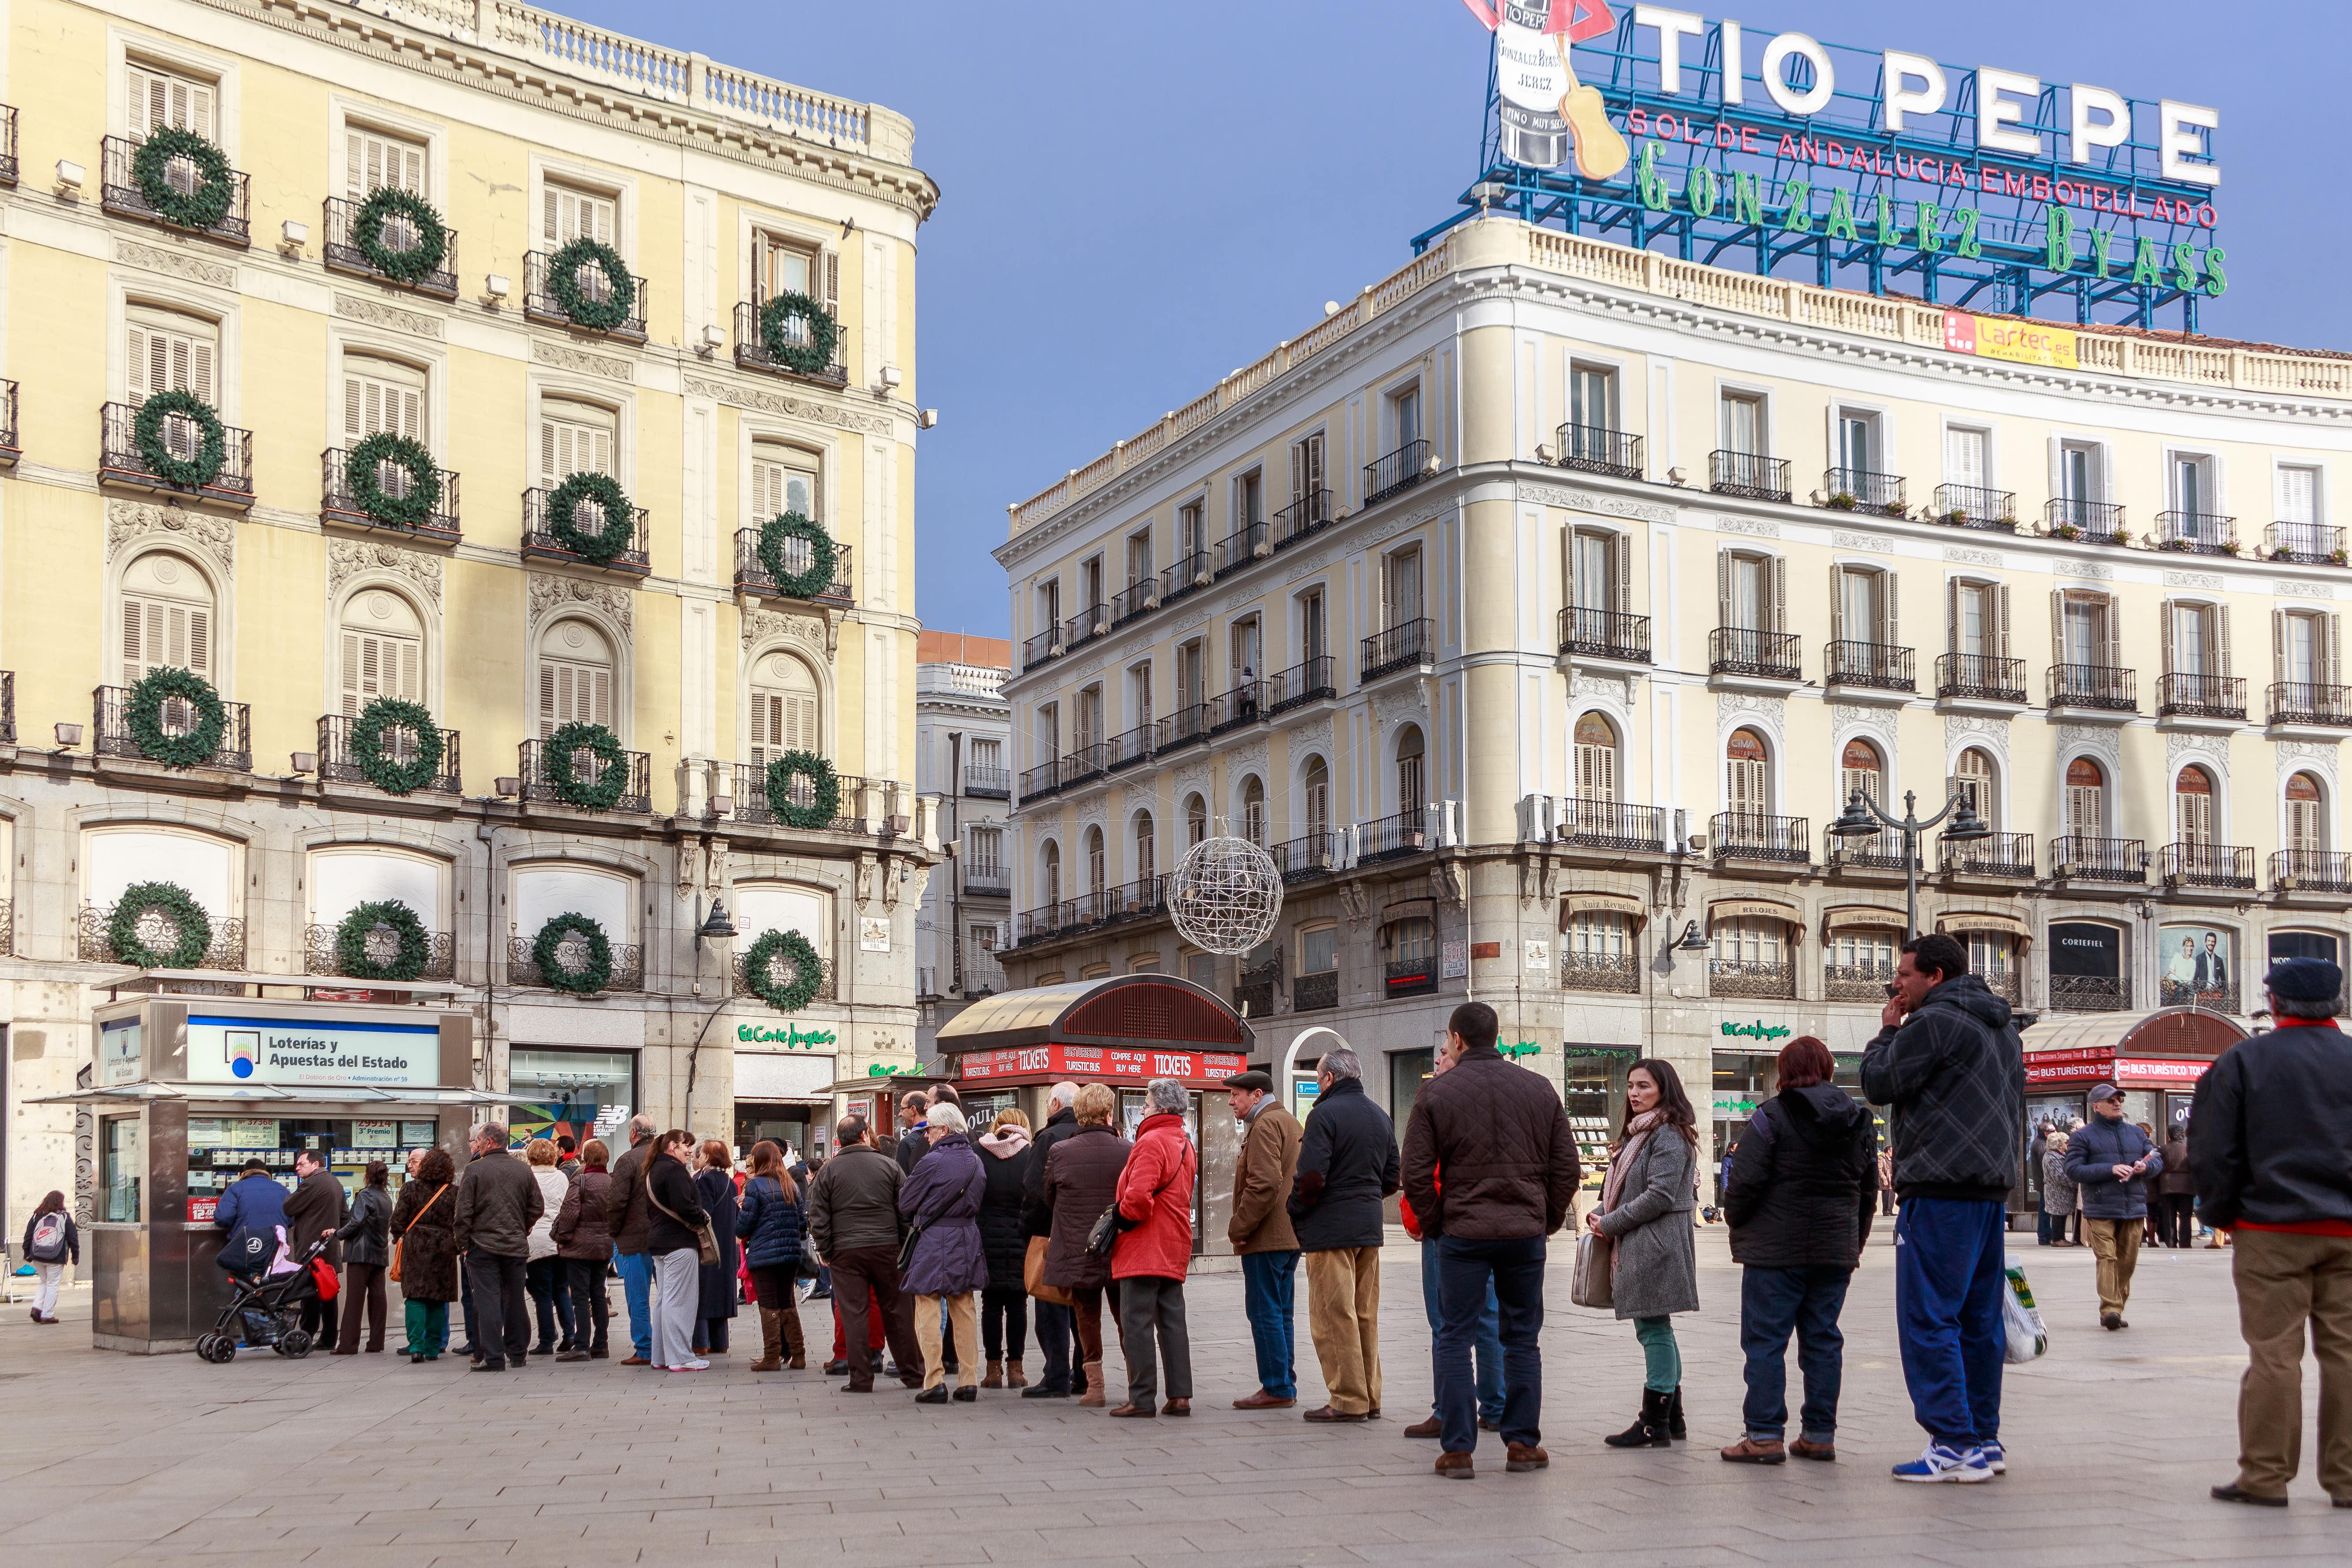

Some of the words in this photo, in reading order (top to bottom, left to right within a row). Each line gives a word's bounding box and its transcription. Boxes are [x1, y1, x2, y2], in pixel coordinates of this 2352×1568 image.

[1498, 37, 1537, 67] GONZALEZ
[1538, 49, 1561, 67] BYASS
[1518, 74, 1552, 91] JEREZ
[1635, 4, 1834, 115] TIO
[1882, 48, 2221, 186] PEPE
[1506, 107, 1528, 125] VINO
[1532, 116, 1549, 129] MUY
[1629, 109, 1703, 145] SOL
[1715, 123, 1760, 153] DE
[1776, 134, 1967, 188] ANDALUCIA
[1981, 168, 2218, 227] EMBOTELLADO
[1637, 140, 1981, 258] GONZALEZ
[2046, 205, 2227, 296] BYASS
[1981, 323, 2070, 356] Lartec.es
[1582, 900, 1600, 909] Ruiz
[1603, 899, 1635, 911] Revuelto
[2062, 938, 2103, 947] CORTEFIEL
[738, 1024, 753, 1043] El
[754, 1025, 787, 1044] Corte
[788, 1022, 836, 1049] Inglés
[1723, 1022, 1734, 1036] El
[1734, 1023, 1757, 1036] Corte
[1756, 1020, 1790, 1041] Inglés
[269, 1037, 326, 1050] Loterías
[330, 1041, 337, 1053] y
[1064, 1047, 1075, 1057] BUS
[1075, 1048, 1103, 1059] TURISTICO
[270, 1053, 334, 1068] Apuestas
[337, 1055, 358, 1067] del
[362, 1056, 408, 1069] Estado
[996, 1052, 1007, 1061] COMPRE
[1018, 1048, 1049, 1070] TICKETS
[1111, 1052, 1131, 1061] COMPRE
[1133, 1053, 1146, 1062] AQUI
[1203, 1055, 1214, 1065] BUS
[1214, 1055, 1239, 1067] TURISTICO
[965, 1067, 982, 1077] TURISTIC
[1065, 1061, 1090, 1071] TURISTIC
[1090, 1062, 1101, 1072] BUS
[1116, 1064, 1127, 1072] BUY
[1128, 1065, 1141, 1073] HERE
[1154, 1054, 1191, 1076] TICKETS
[1205, 1068, 1228, 1078] TURISTIC
[2041, 1068, 2056, 1077] BUS
[2056, 1064, 2095, 1076] TURÍSTICO
[2131, 1063, 2147, 1074] BUS
[2147, 1062, 2187, 1076] TURÍSTICO
[1713, 1098, 1728, 1108] orte
[1729, 1096, 1757, 1112] Inglés
[967, 1109, 998, 1130] OUIJ
